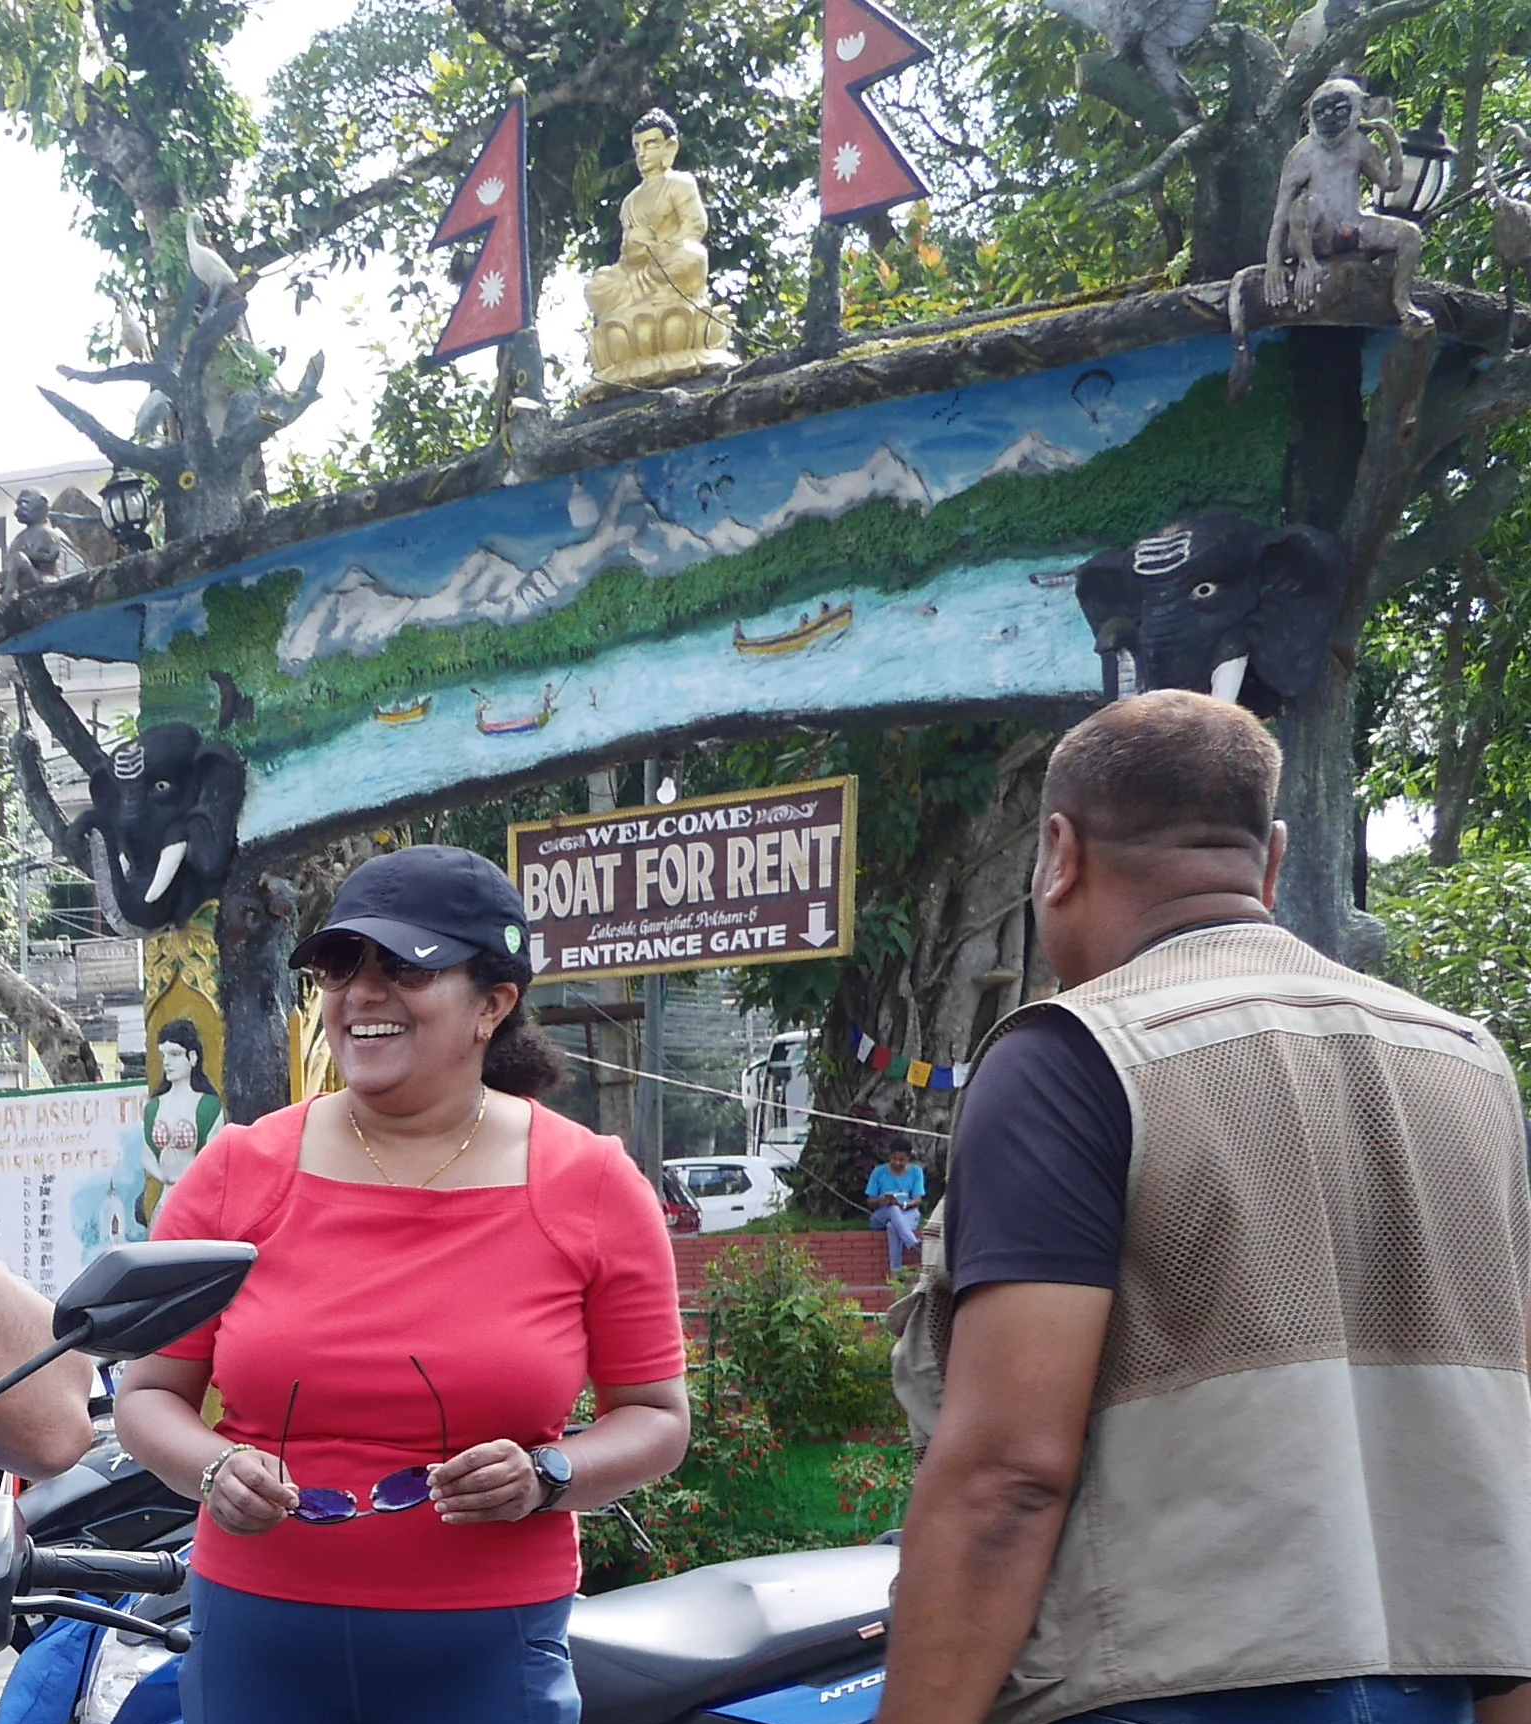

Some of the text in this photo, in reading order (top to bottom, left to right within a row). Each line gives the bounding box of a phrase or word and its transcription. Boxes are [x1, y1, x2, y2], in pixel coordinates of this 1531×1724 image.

[586, 805, 752, 848] WELCOME
[523, 824, 840, 921] BOAT FOR RENT
[561, 924, 787, 969] ENTRANCE GATE
